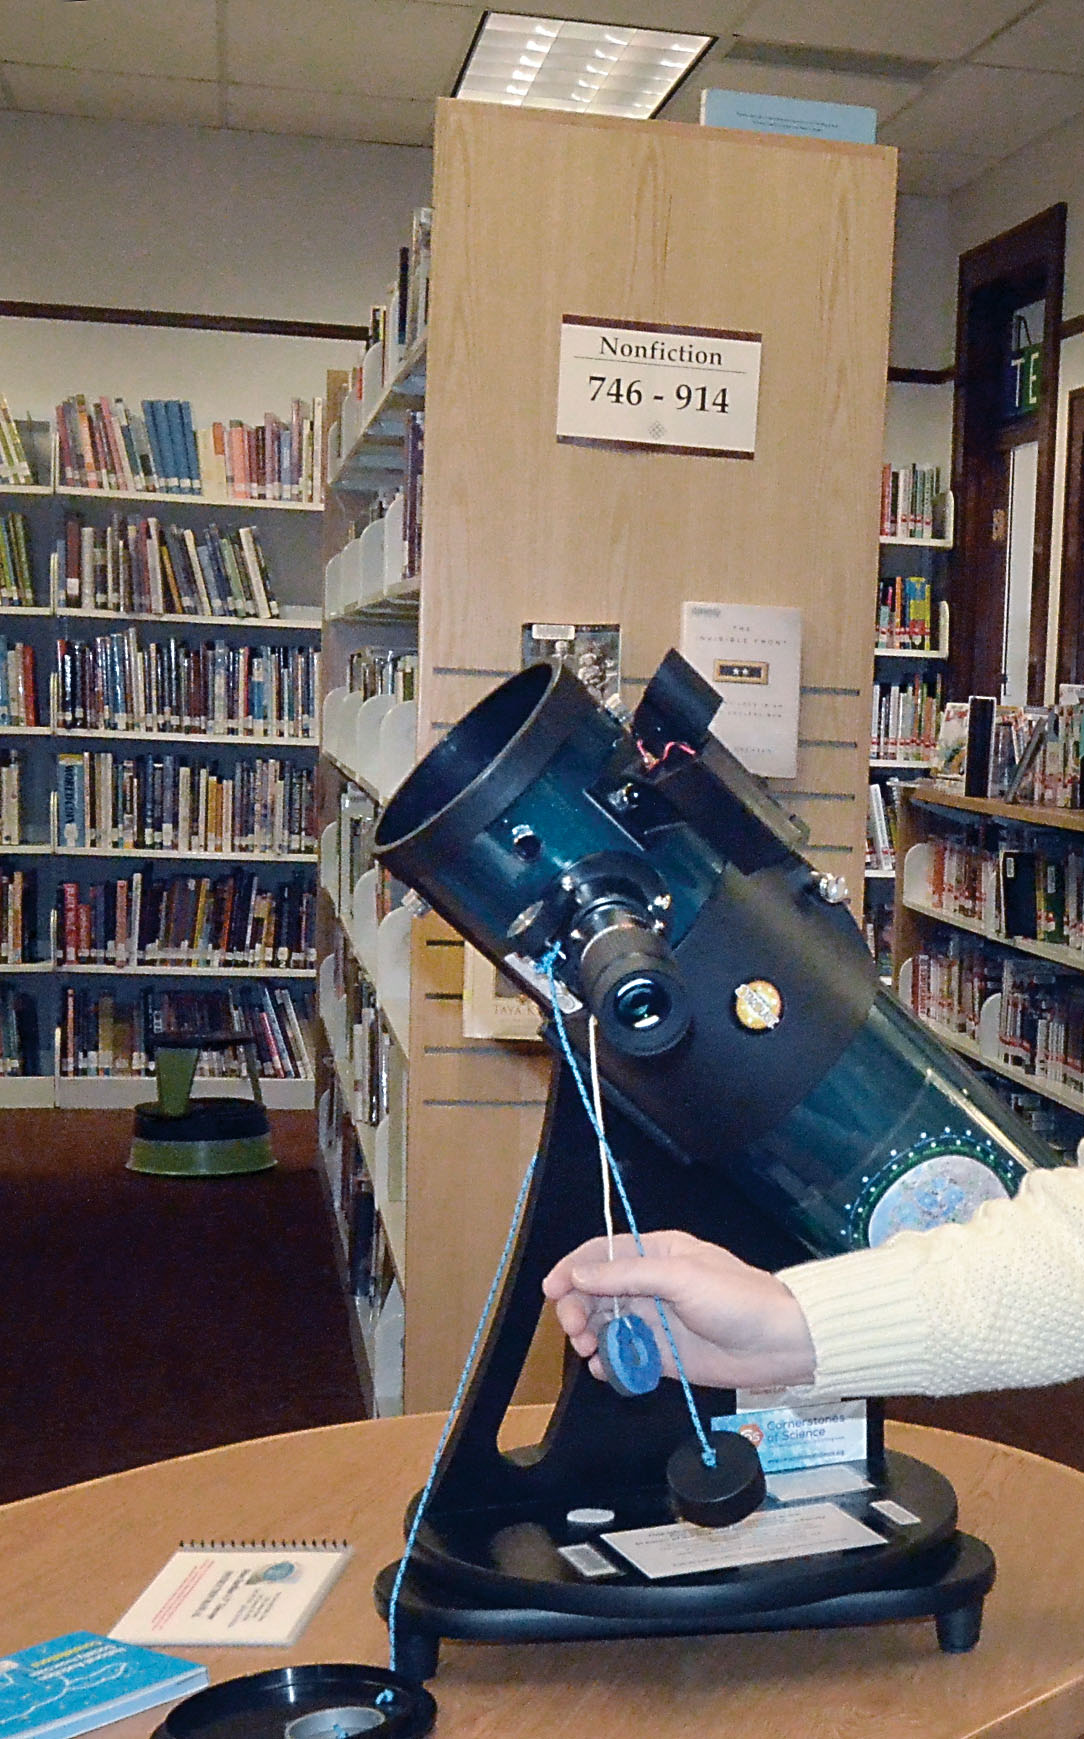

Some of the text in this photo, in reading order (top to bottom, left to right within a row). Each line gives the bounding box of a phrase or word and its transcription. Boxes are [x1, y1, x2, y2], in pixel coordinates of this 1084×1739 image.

[599, 336, 722, 366] Nonfiction
[588, 375, 643, 406] 746
[675, 384, 729, 414] 914
[766, 1414, 846, 1432] Cornerstones
[783, 1428, 826, 1441] Science
